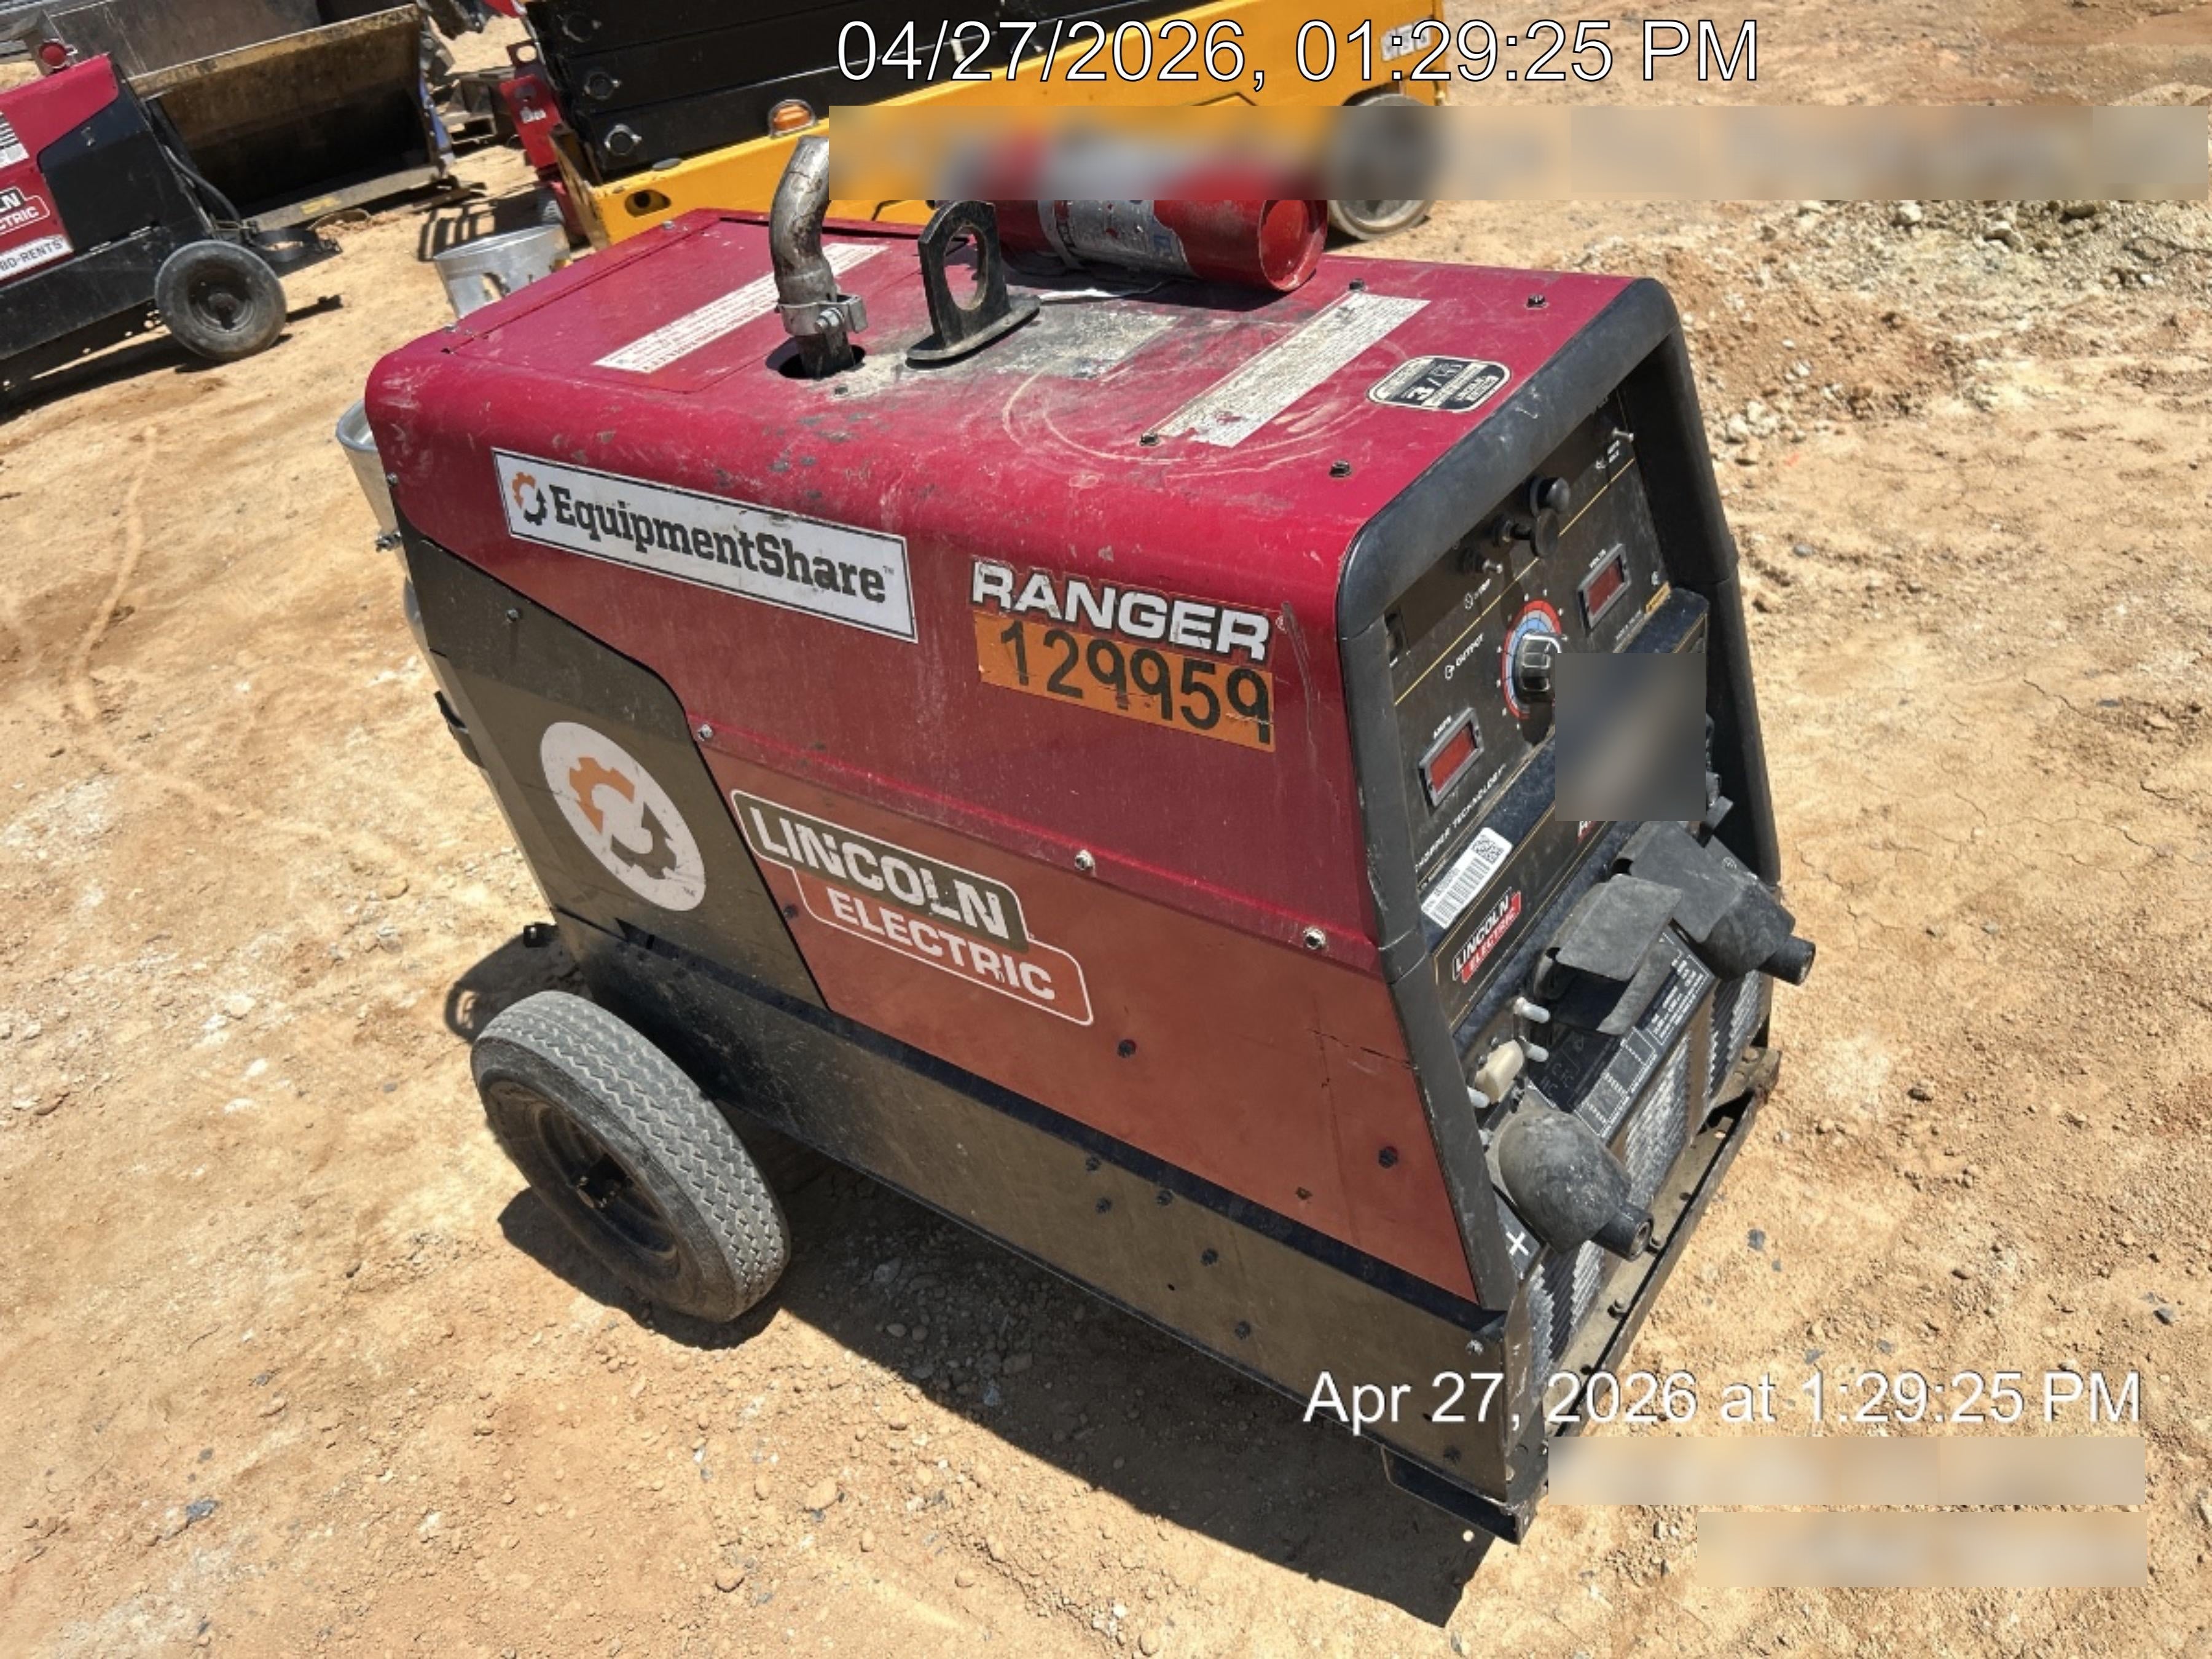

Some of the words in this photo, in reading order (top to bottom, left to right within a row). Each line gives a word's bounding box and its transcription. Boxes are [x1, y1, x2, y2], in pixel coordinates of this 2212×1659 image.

[549, 485, 885, 603] EquipmentShare
[971, 560, 1271, 662] RANGER
[1000, 621, 1271, 744] 129959
[750, 806, 1010, 939] LINCOLN
[826, 887, 1055, 1000] ELECTRIC
[1456, 895, 1510, 971] LINCOLN
